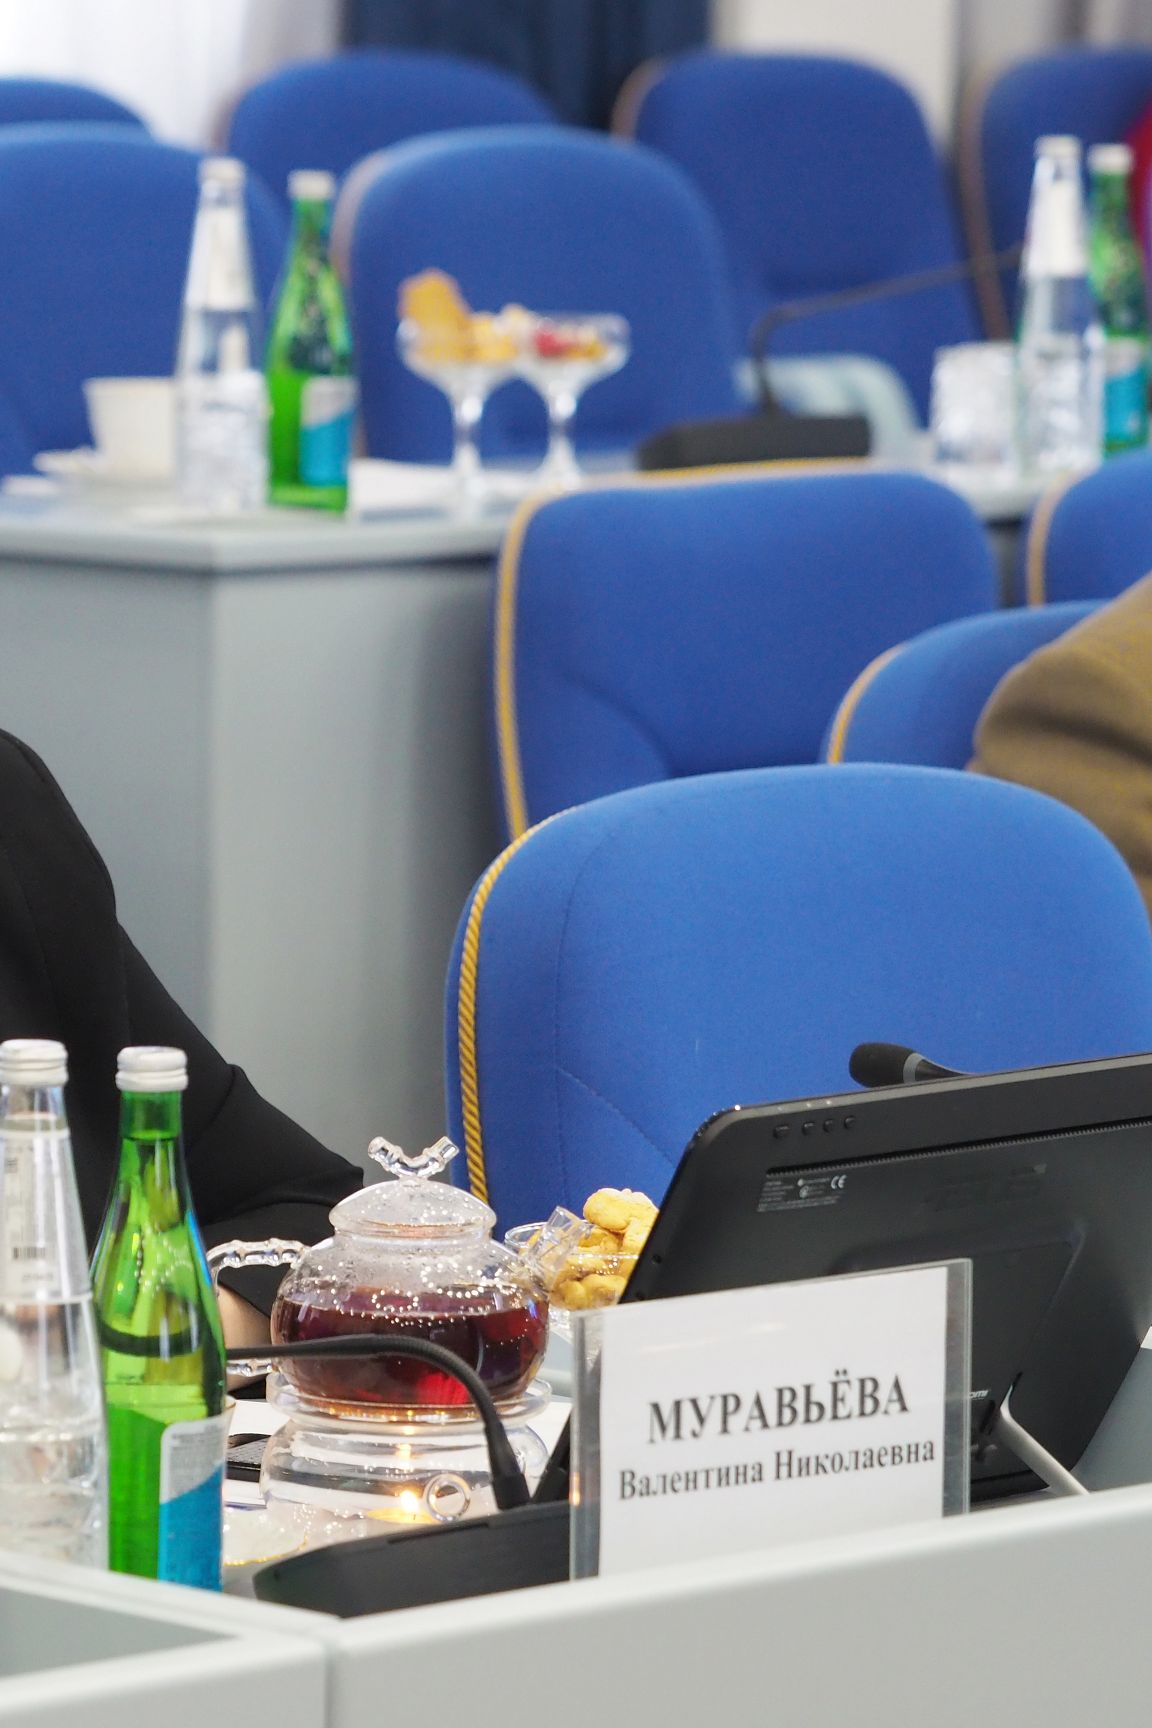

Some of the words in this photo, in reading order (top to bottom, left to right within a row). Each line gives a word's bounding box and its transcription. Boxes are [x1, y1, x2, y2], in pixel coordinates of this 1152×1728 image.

[648, 1368, 910, 1444] МУРАВЬЁВА
[619, 1461, 764, 1500] Валентина
[774, 1439, 935, 1481] Николаевна
